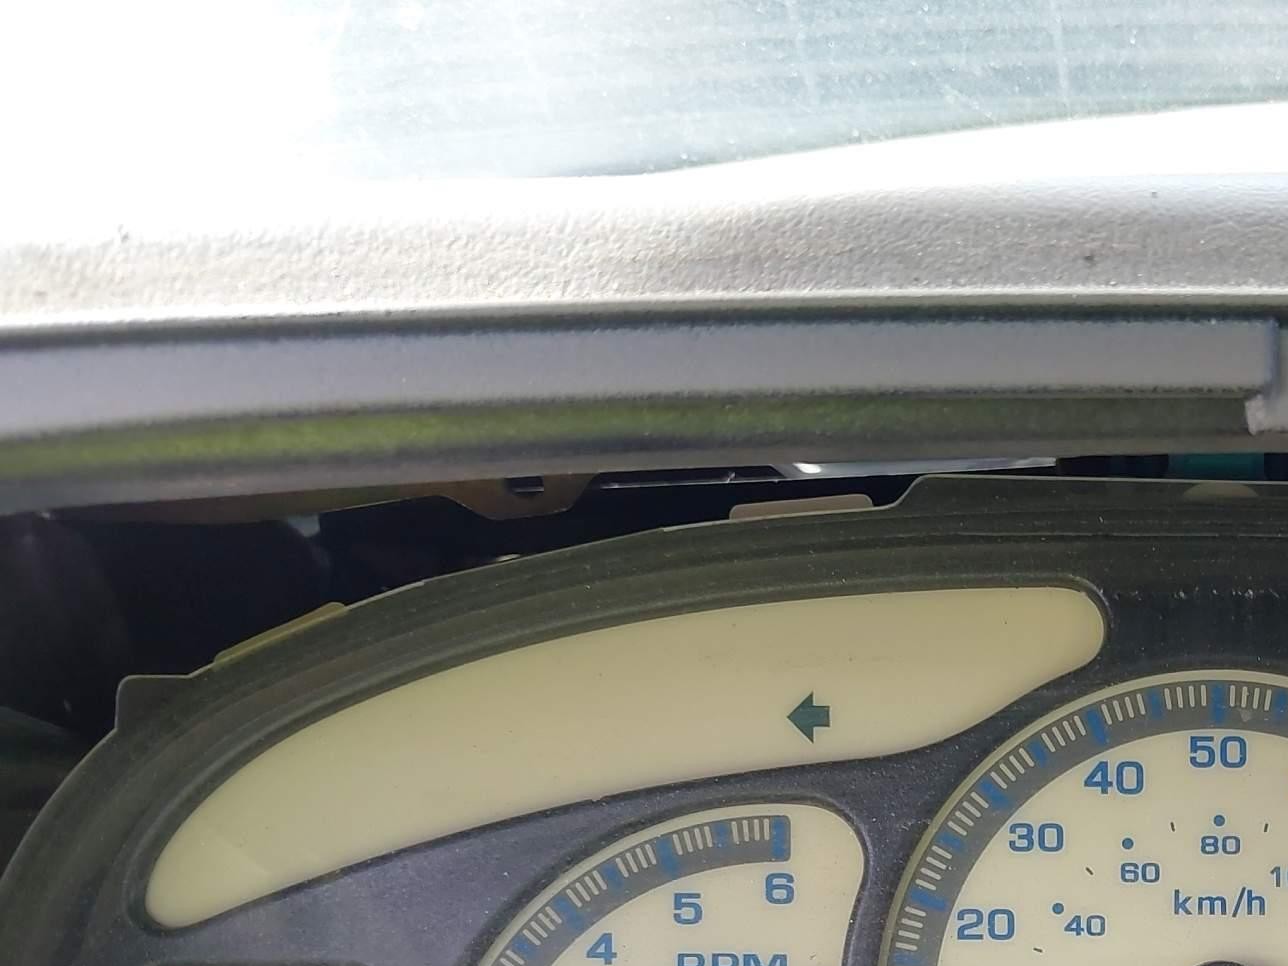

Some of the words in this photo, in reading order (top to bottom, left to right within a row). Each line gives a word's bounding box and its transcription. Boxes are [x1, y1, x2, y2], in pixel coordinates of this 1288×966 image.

[1190, 736, 1246, 768] 50
[1084, 761, 1143, 794] 40
[1009, 823, 1063, 852] 30
[1201, 836, 1240, 854] 80
[766, 873, 794, 904] 6
[1121, 863, 1160, 883] 60
[674, 893, 702, 924] 5
[1175, 887, 1265, 917] km/h
[957, 909, 1014, 940] 20
[1064, 915, 1105, 936] 40
[587, 933, 617, 965] 4
